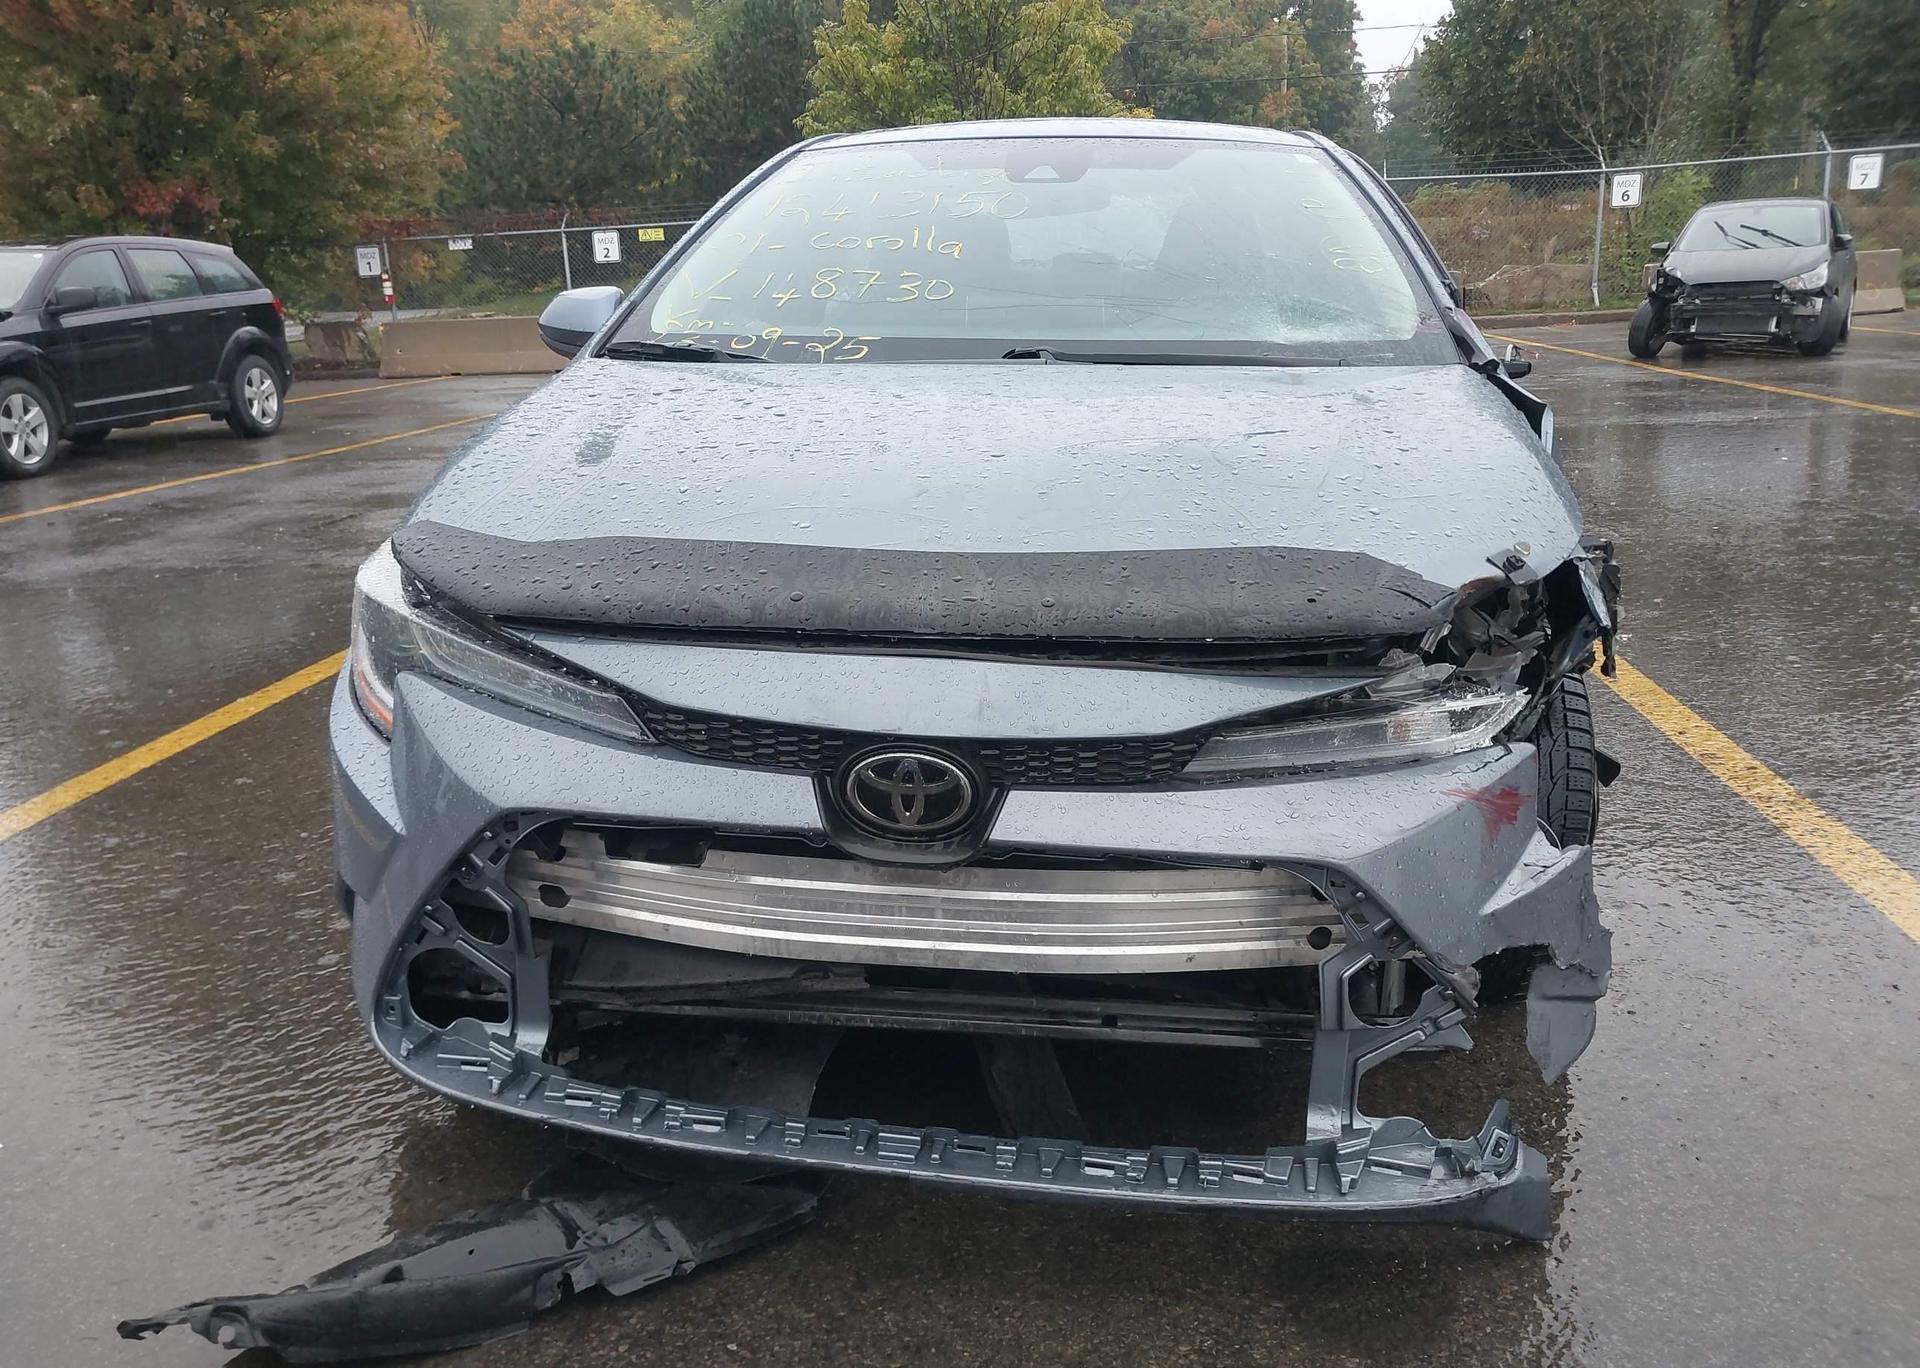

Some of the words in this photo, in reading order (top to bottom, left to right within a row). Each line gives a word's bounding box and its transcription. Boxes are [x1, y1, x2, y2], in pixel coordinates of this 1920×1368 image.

[1616, 180, 1638, 189] MDZ
[1860, 173, 1869, 185] 7
[1621, 190, 1630, 202] 6
[597, 237, 615, 245] MDZ
[603, 247, 611, 259] 2
[366, 261, 372, 272] 1
[752, 267, 955, 309] 148730
